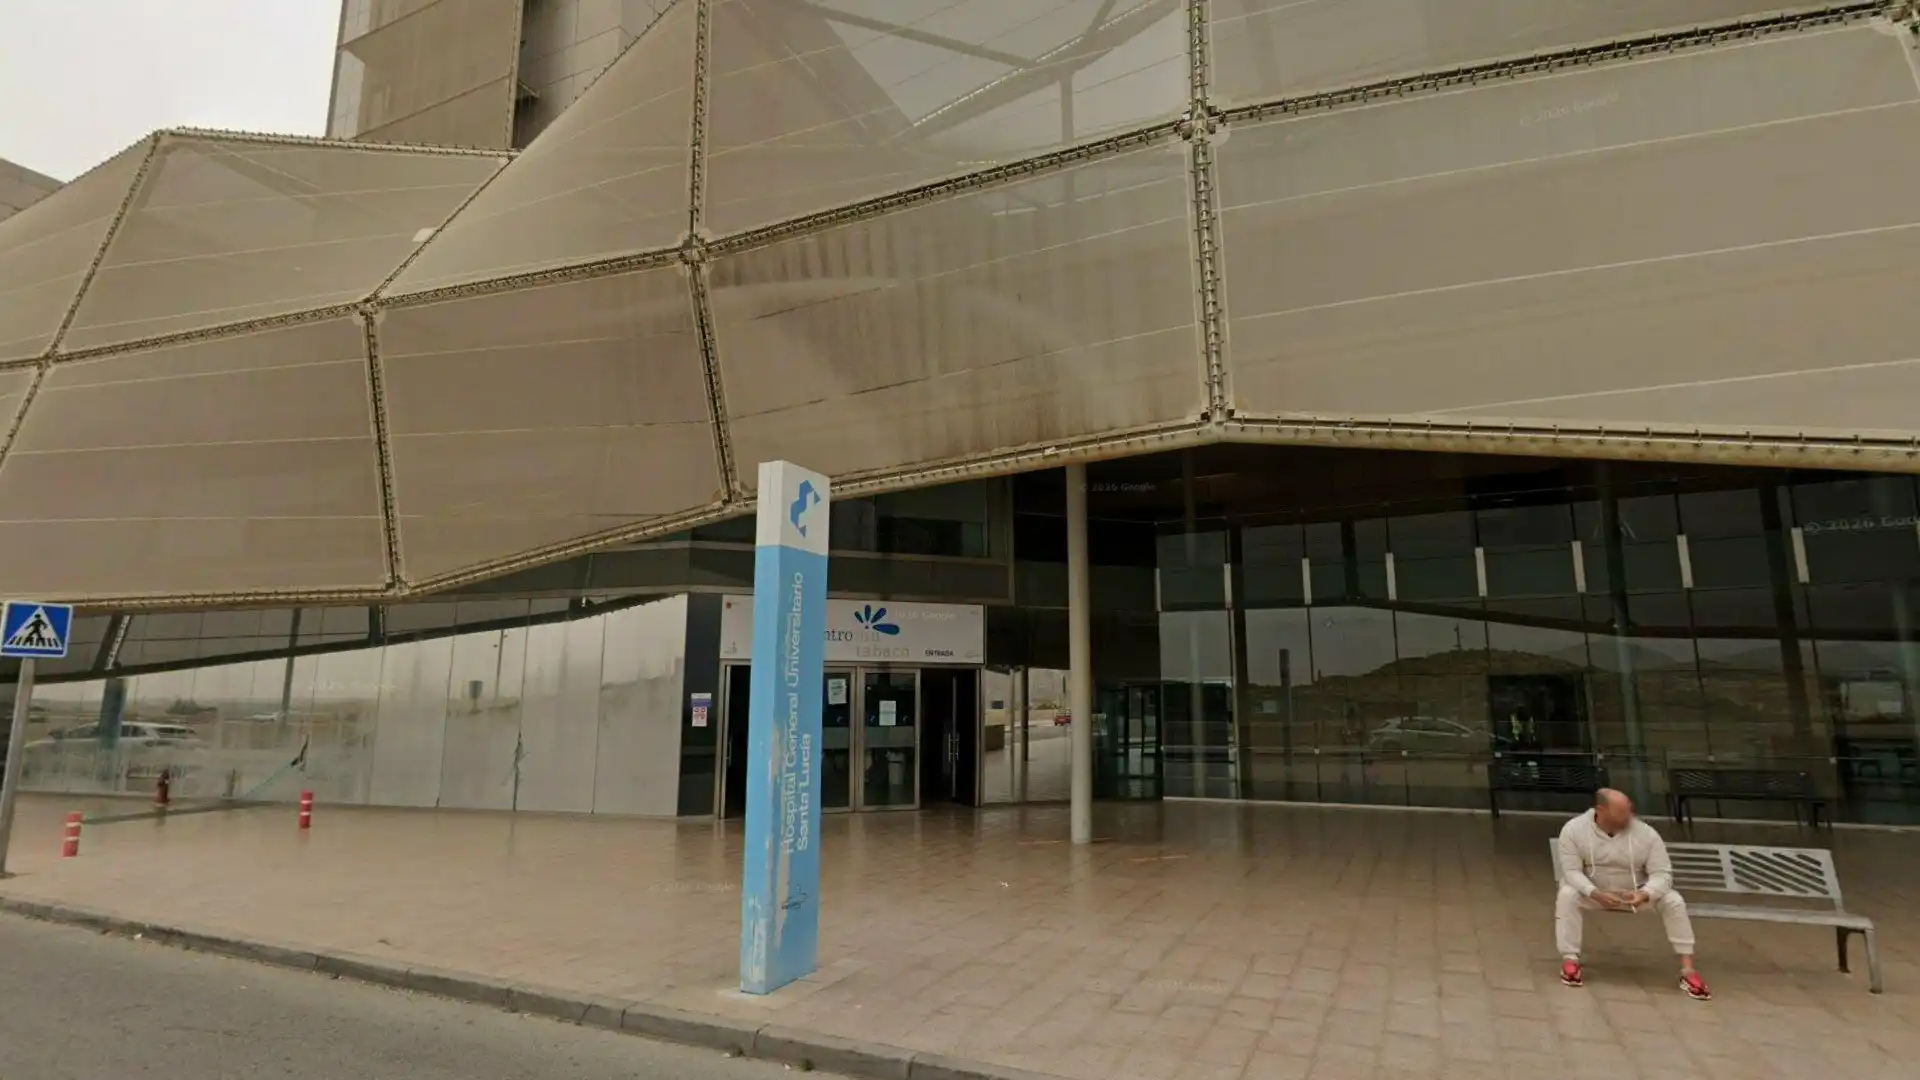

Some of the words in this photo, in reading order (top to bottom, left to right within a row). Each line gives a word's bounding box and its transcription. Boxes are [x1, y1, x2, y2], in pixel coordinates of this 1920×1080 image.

[787, 572, 804, 688] Universitario
[924, 649, 955, 657] ENTRADA
[785, 692, 799, 768] General
[781, 772, 801, 854] Hospital
[797, 793, 810, 851] Santa
